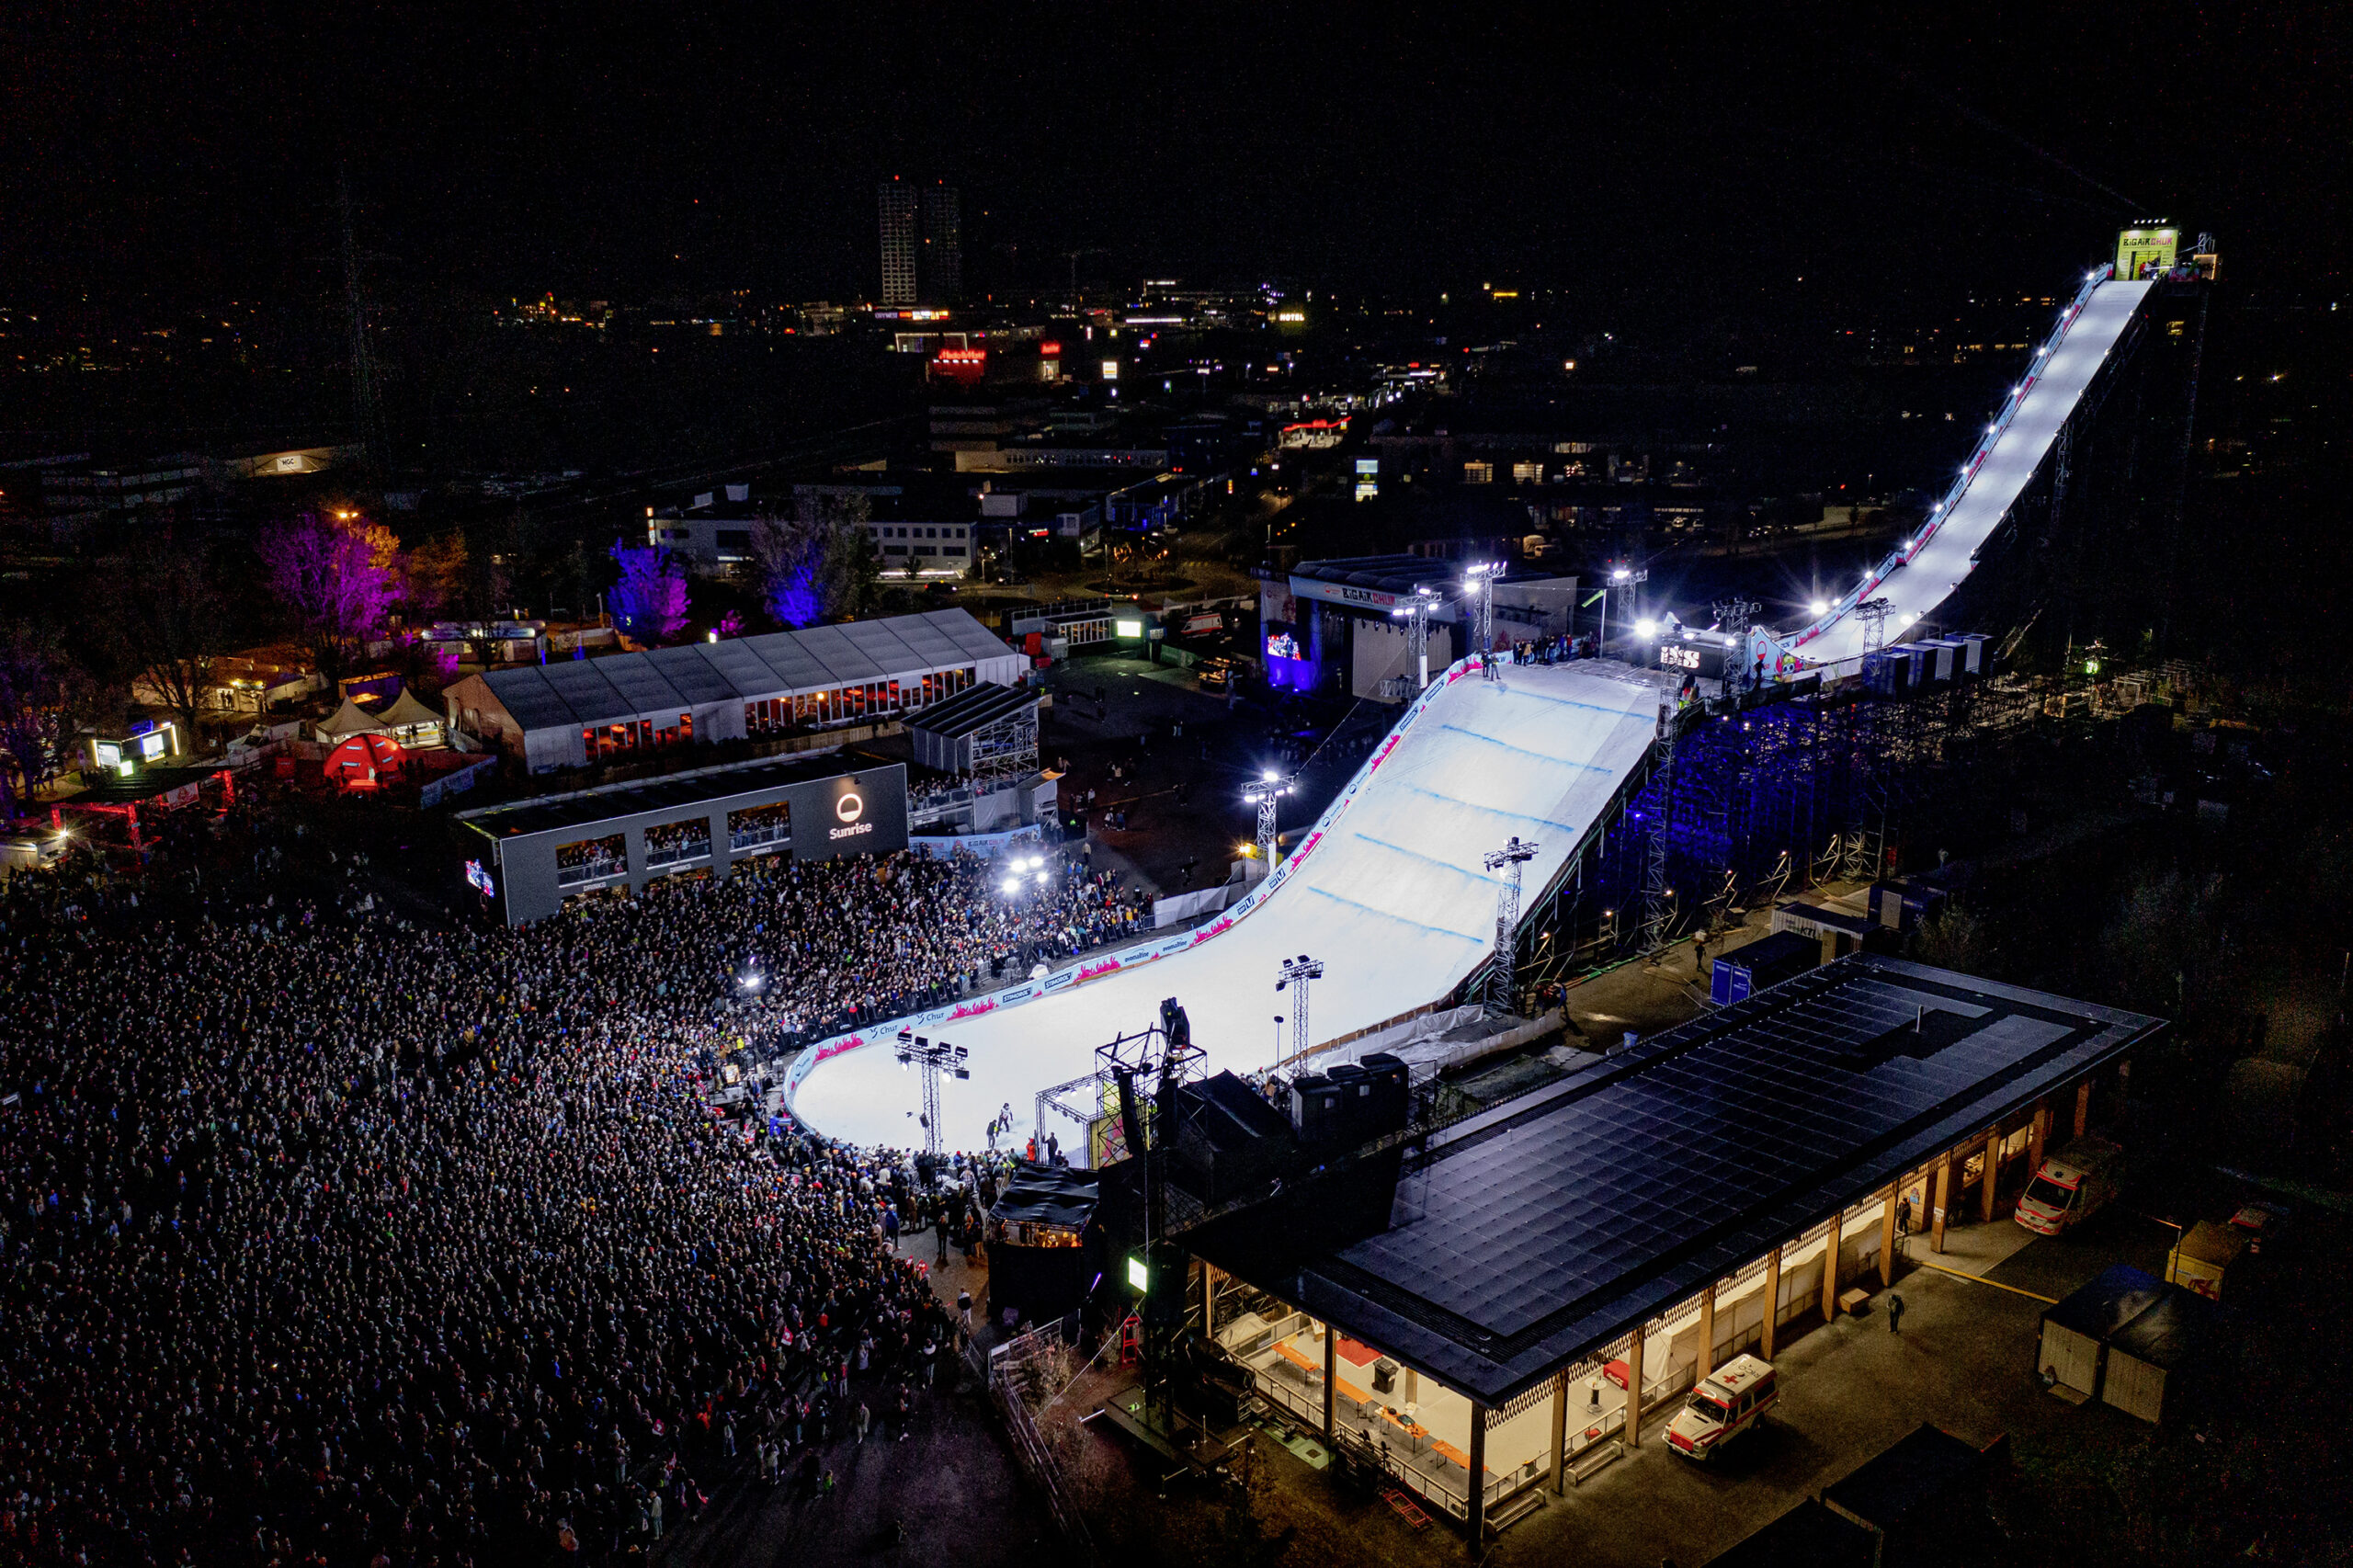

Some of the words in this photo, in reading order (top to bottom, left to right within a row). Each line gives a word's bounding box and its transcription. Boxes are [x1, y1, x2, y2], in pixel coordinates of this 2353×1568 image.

[1279, 312, 1305, 322] HOTEL
[829, 822, 872, 840] Sunrise
[926, 1012, 944, 1021] Chur
[880, 1024, 898, 1035] Chur
